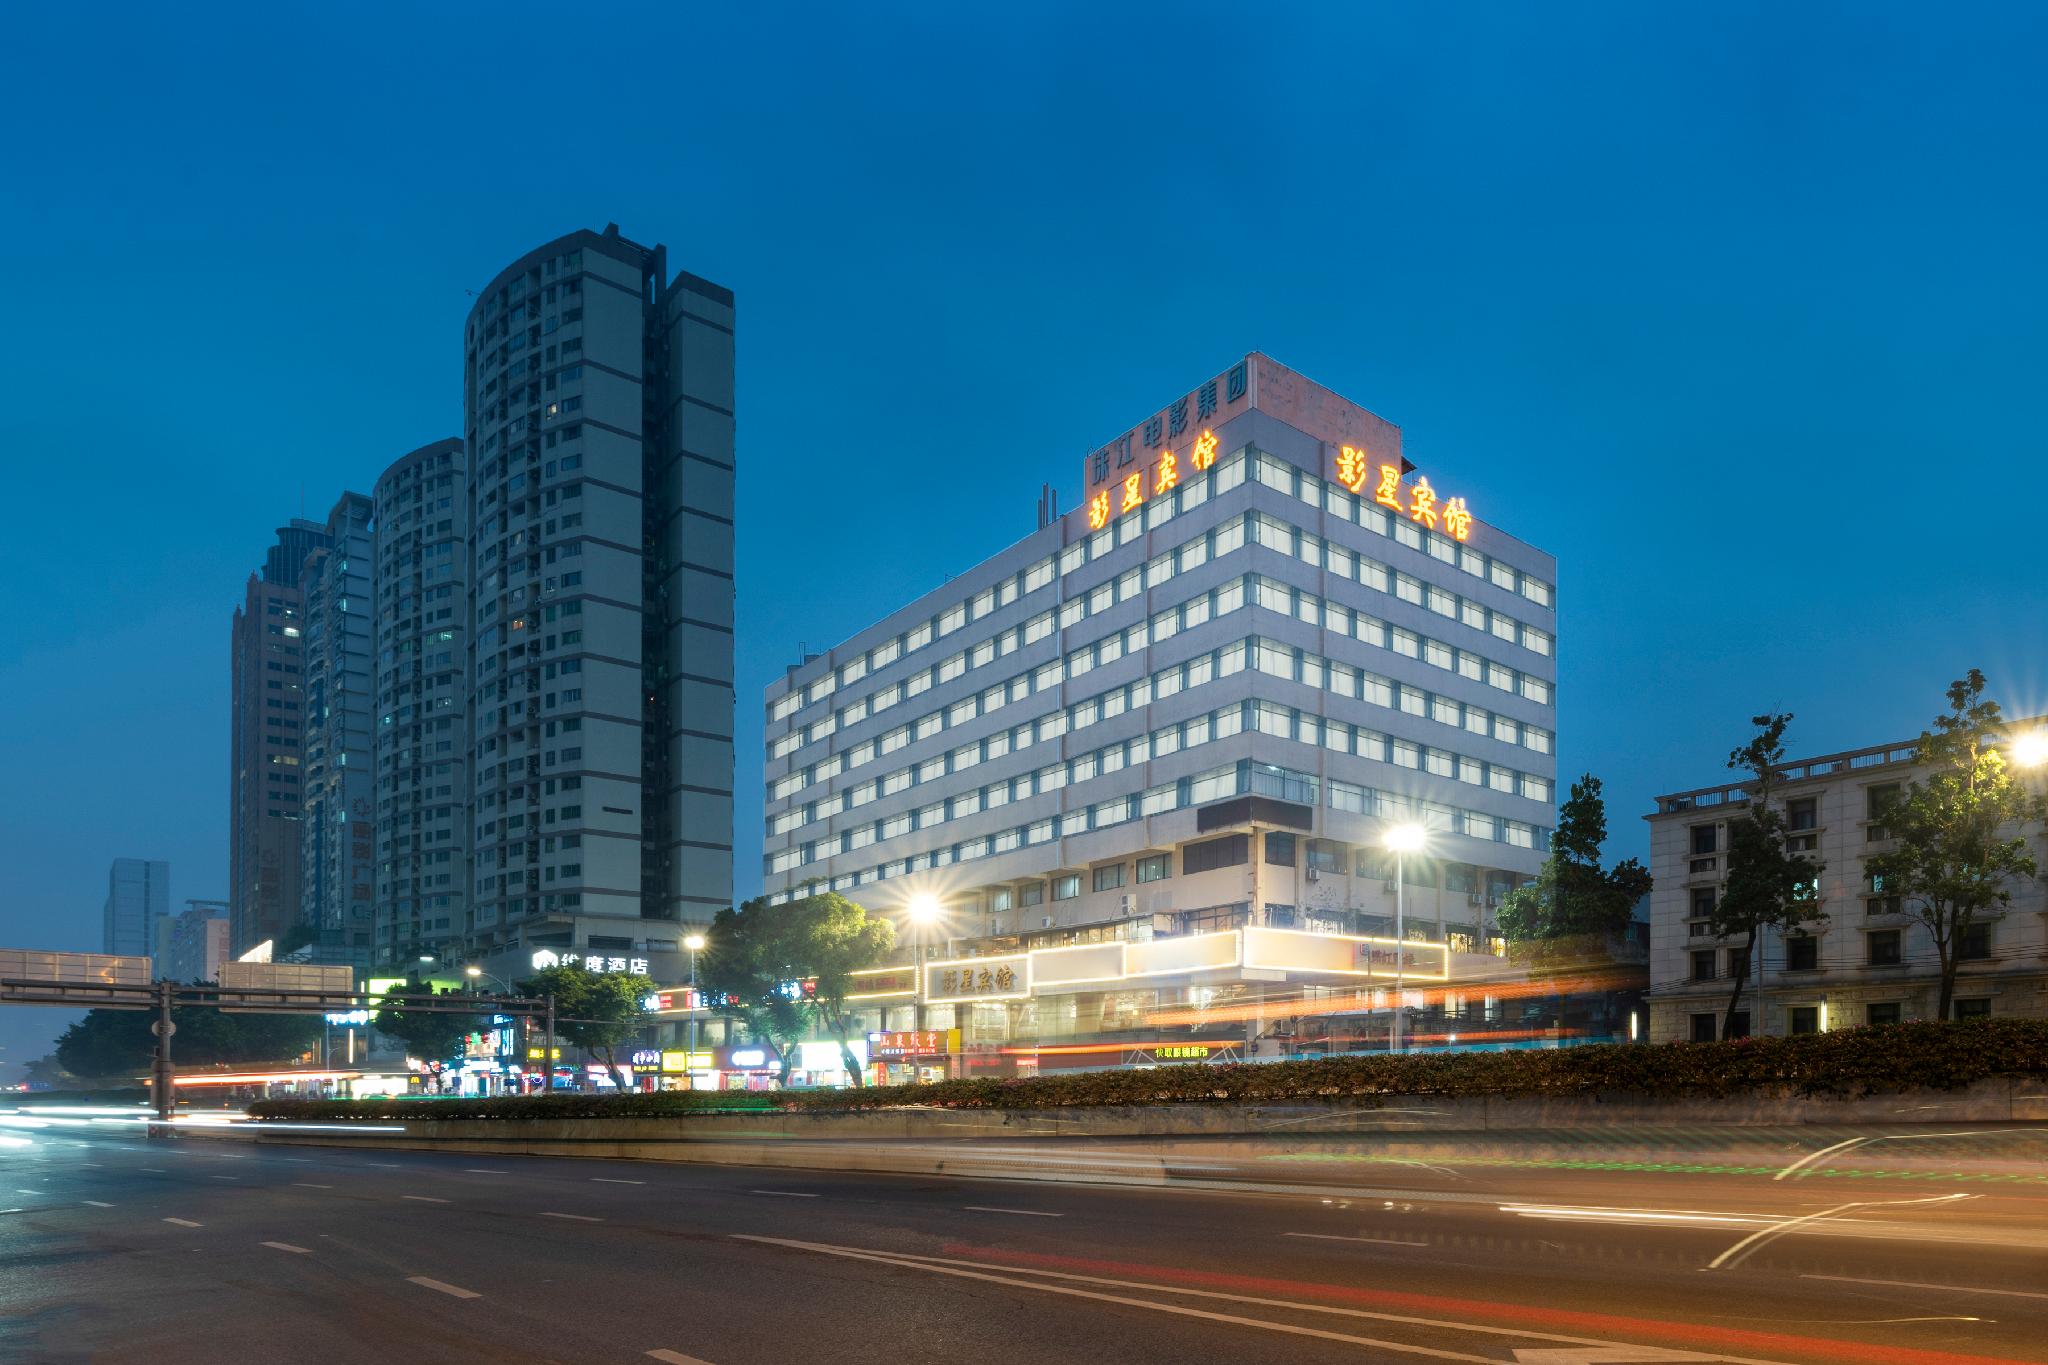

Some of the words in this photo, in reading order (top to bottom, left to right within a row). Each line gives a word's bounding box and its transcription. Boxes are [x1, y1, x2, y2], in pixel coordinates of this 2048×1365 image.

[1092, 361, 1248, 487] 珠江电影集团
[1088, 430, 1219, 530] 影星宾馆
[1336, 446, 1472, 541] 影星宾馆
